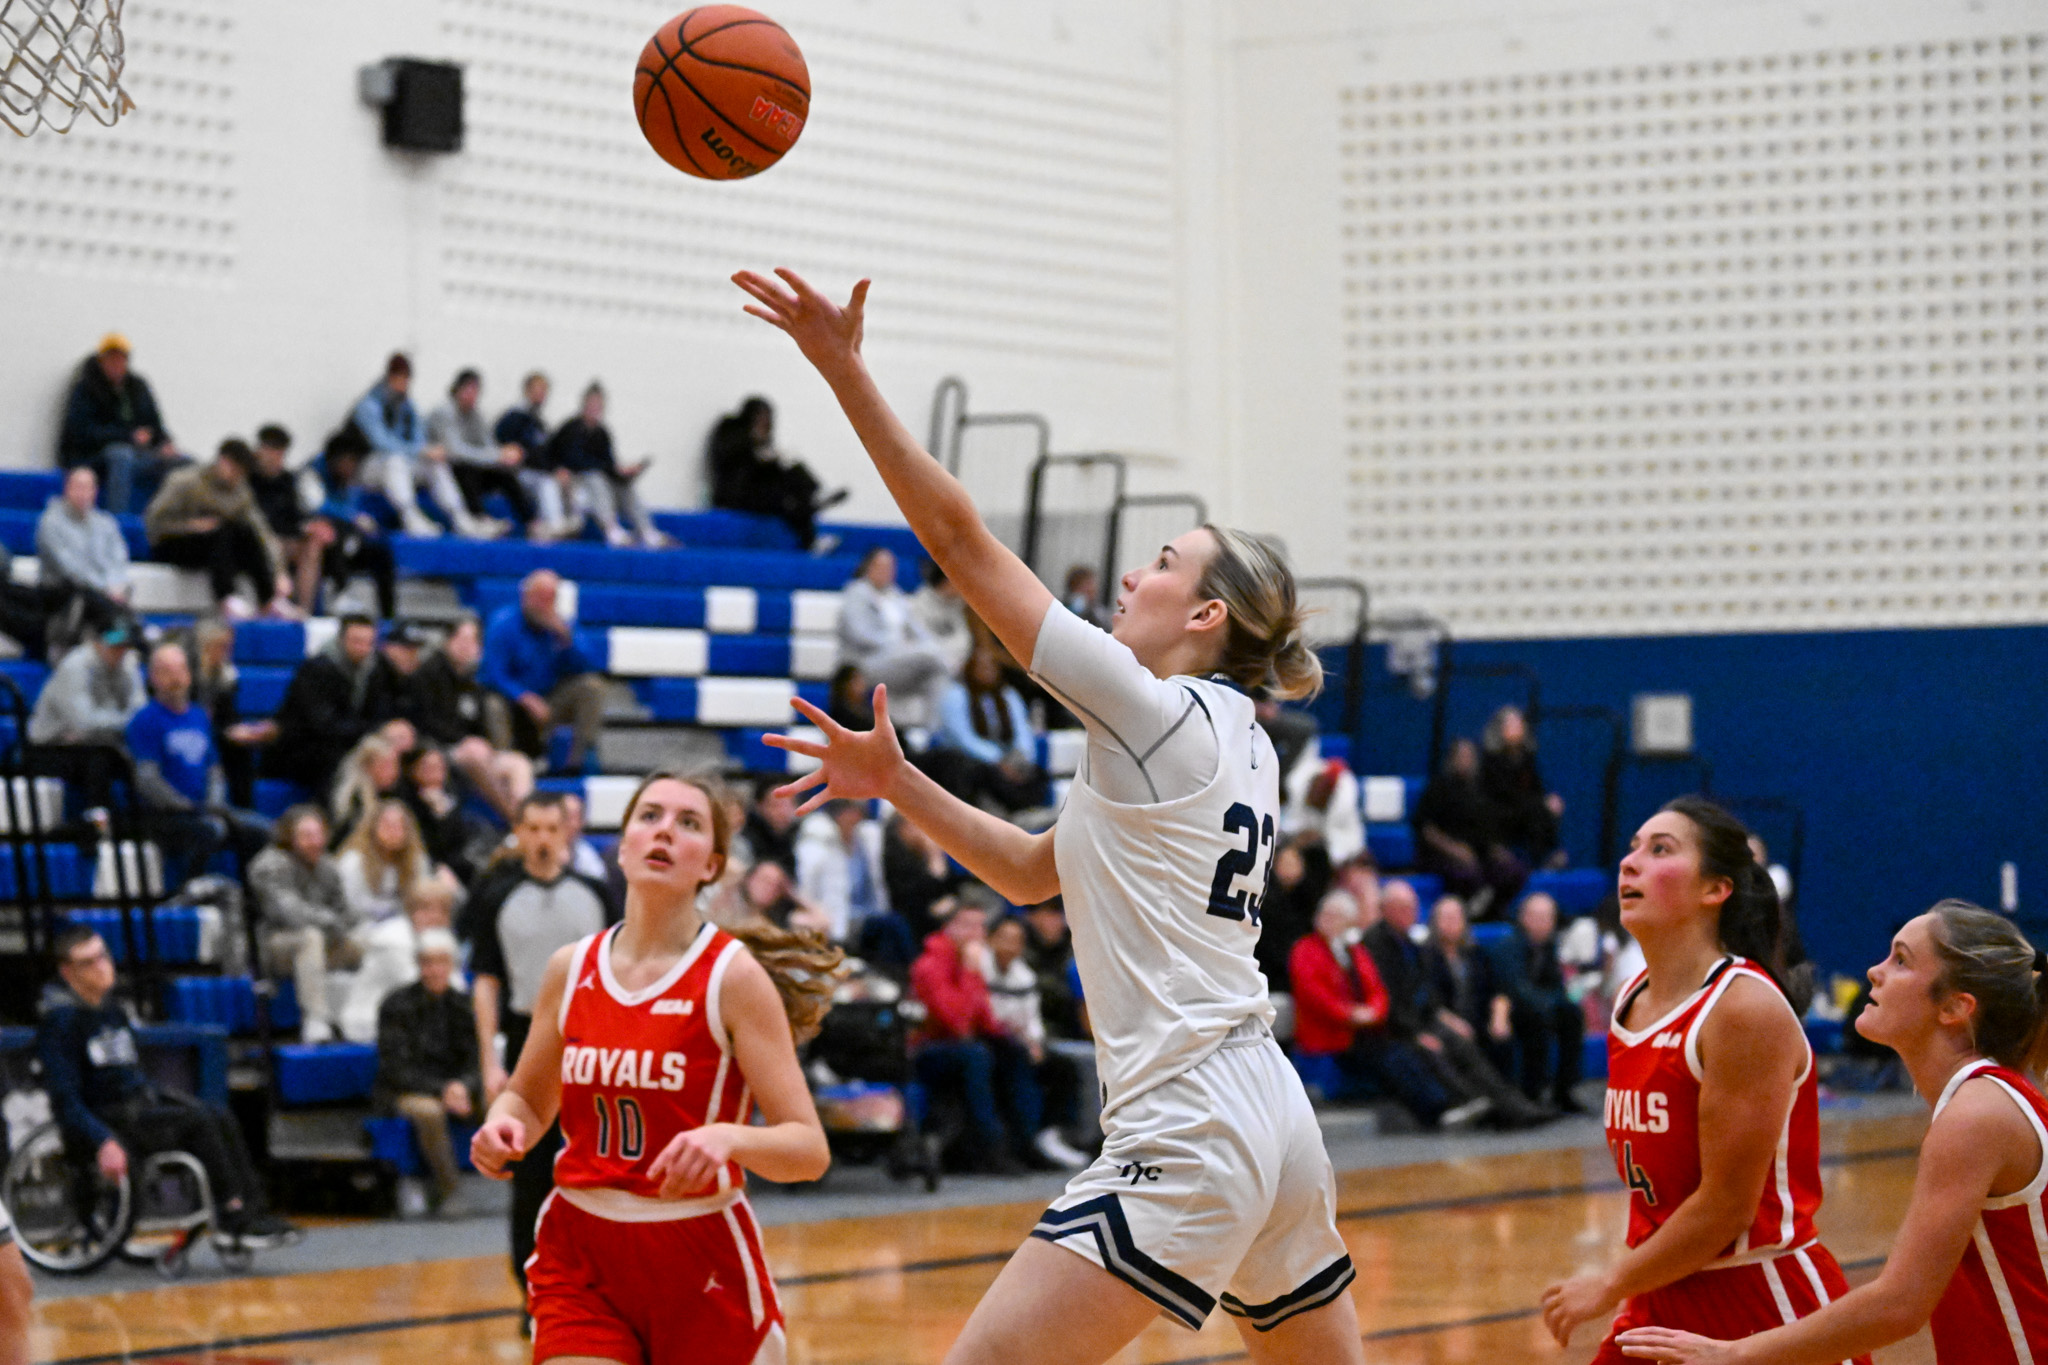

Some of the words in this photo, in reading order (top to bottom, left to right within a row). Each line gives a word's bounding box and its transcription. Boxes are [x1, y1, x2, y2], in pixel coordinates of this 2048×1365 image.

[1206, 801, 1275, 927] 23
[561, 1046, 687, 1092] ROYALS
[595, 1093, 645, 1161] 10
[1604, 1087, 1669, 1134] OYALS
